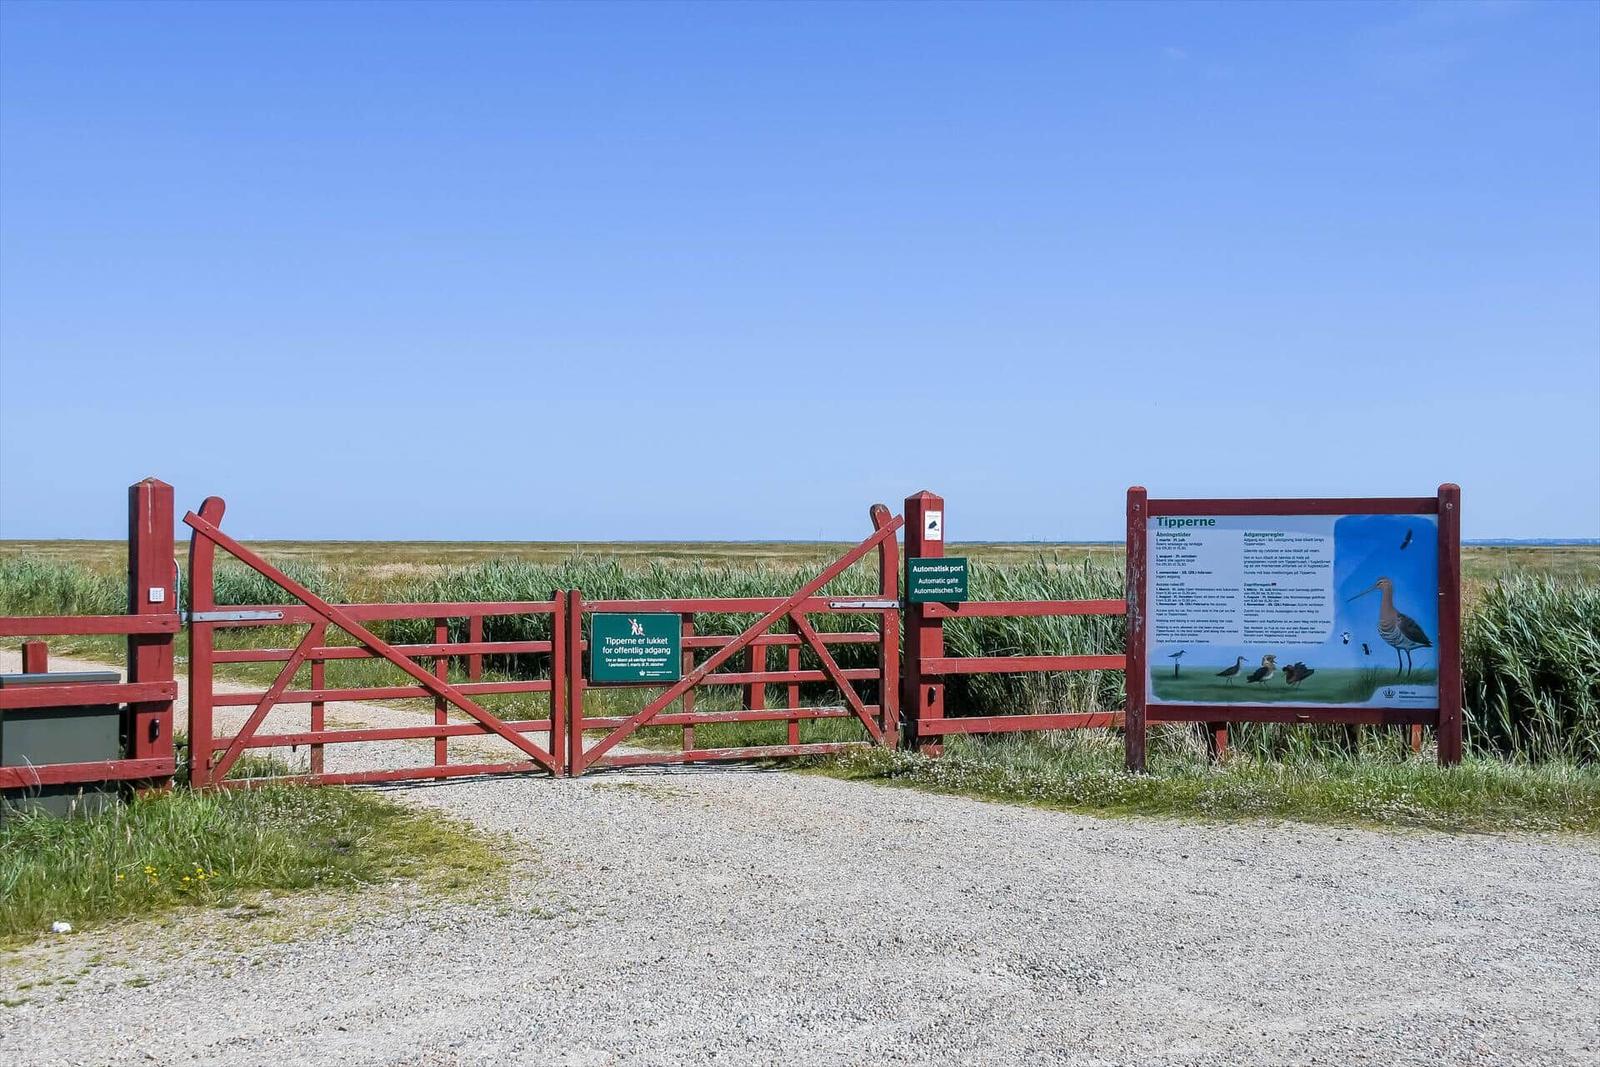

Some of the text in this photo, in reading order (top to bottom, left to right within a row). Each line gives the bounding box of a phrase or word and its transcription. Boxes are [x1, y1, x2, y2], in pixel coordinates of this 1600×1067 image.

[1156, 516, 1216, 528] Tipperne
[950, 565, 964, 573] port
[605, 637, 637, 646] Tipperne
[646, 637, 668, 645] lukket
[602, 646, 671, 655] for offentlig adgang
